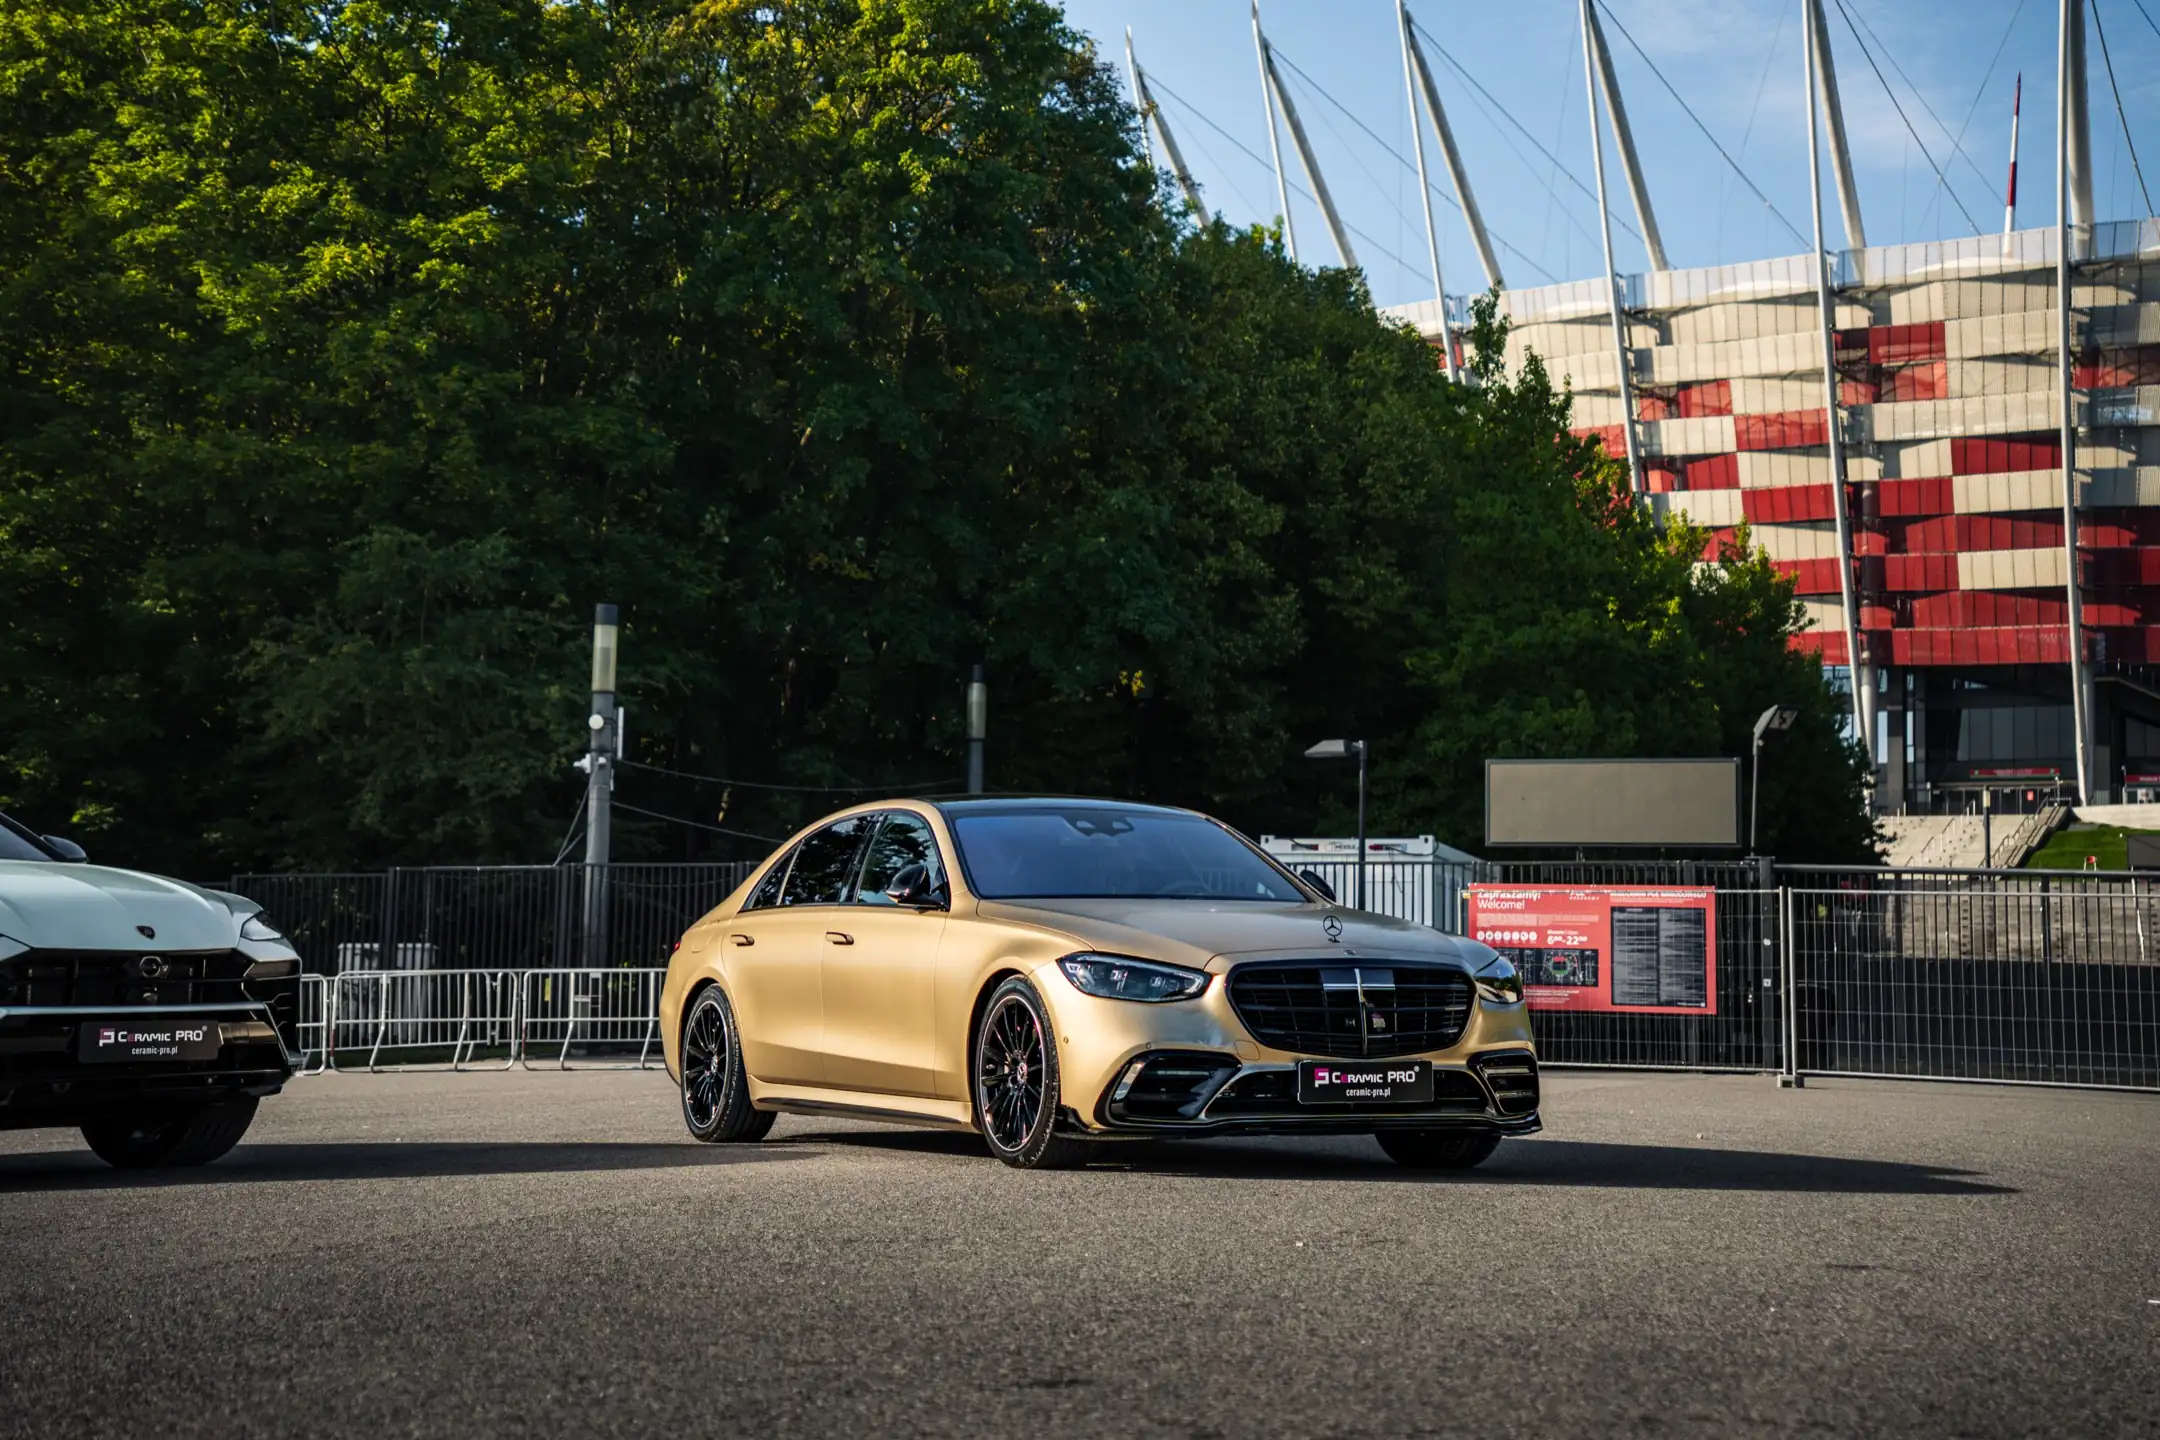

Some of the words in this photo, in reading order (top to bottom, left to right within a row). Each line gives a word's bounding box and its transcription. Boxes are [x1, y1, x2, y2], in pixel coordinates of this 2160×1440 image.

[1477, 899, 1525, 910] Welcome!
[131, 1046, 178, 1055] ceramic-pro.pl
[1345, 1087, 1391, 1098] ceramic-pro.pl
